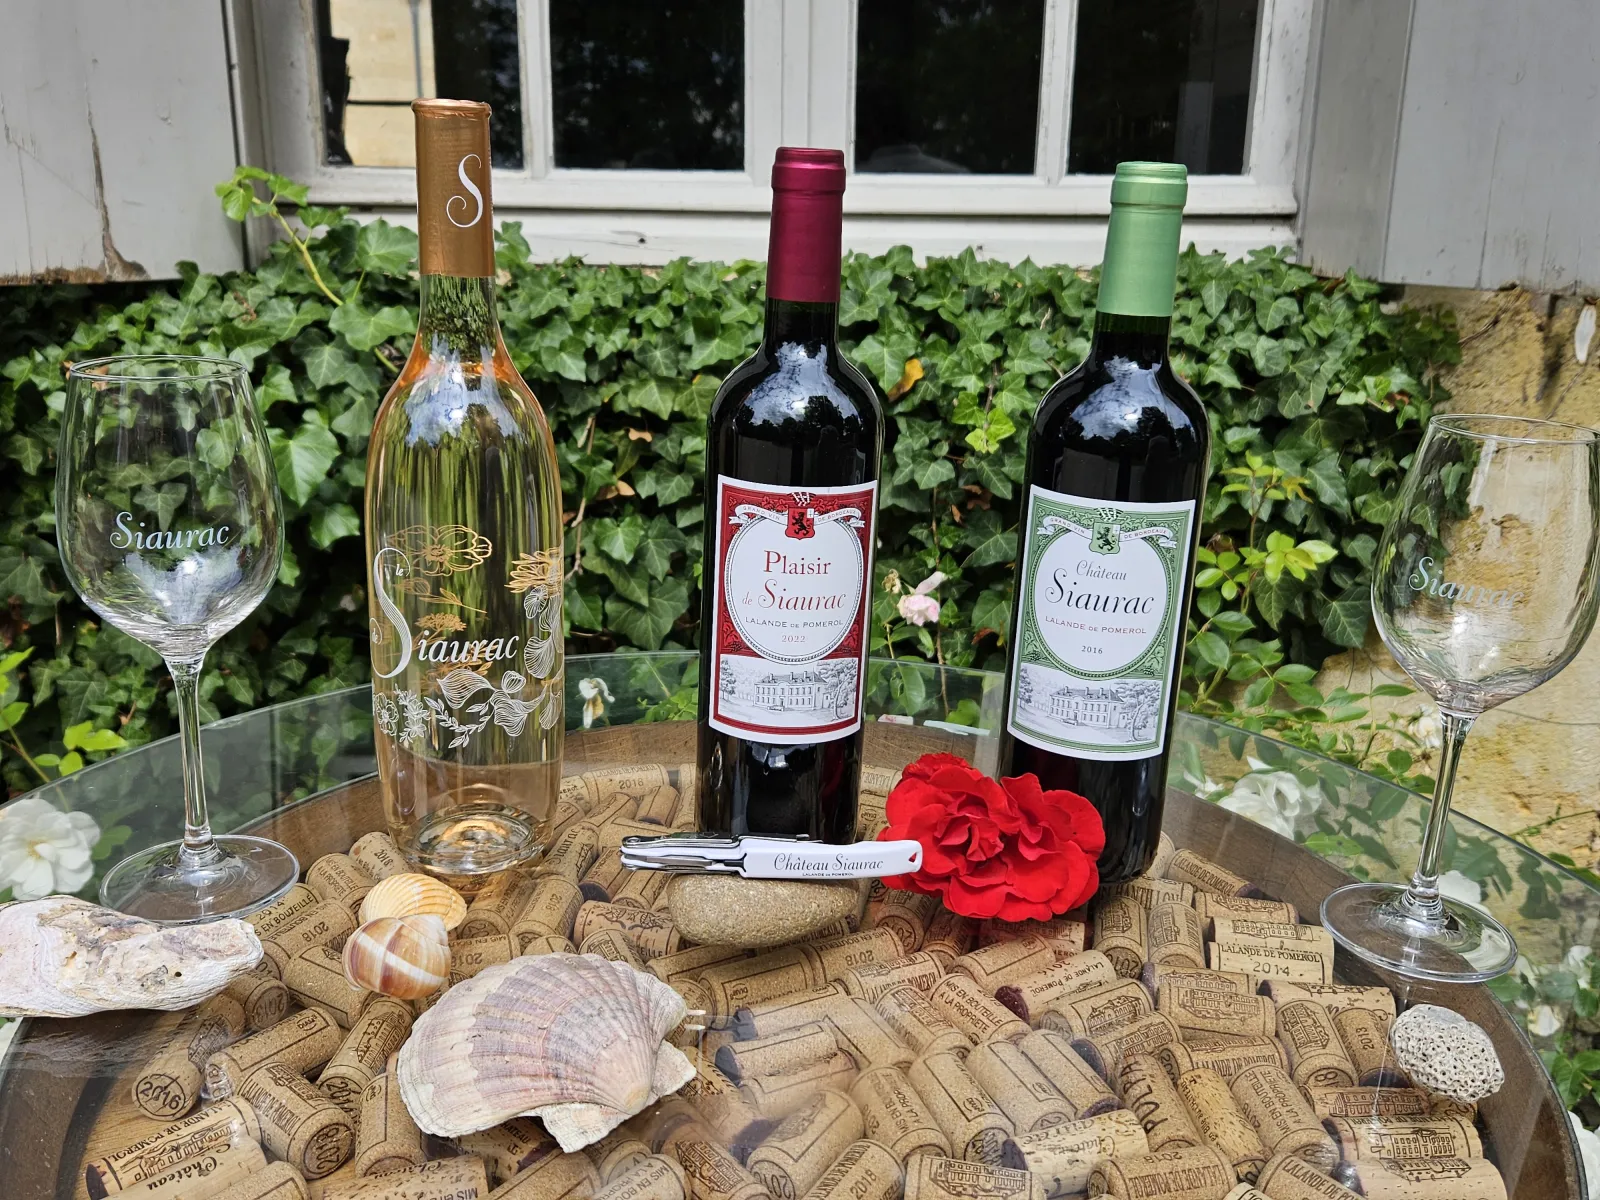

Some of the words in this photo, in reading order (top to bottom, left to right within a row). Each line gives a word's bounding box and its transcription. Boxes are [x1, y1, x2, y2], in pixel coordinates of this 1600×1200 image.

[447, 153, 483, 228] S
[110, 511, 229, 549] Siaurac
[763, 549, 831, 576] Plaisir
[1076, 559, 1128, 581] Château
[1045, 567, 1155, 615] Siaurac
[1408, 556, 1525, 609] Siaurac
[742, 591, 753, 606] de
[758, 578, 847, 611] Siaurac
[745, 617, 788, 628] LALANDE
[802, 619, 844, 629] POMEROL
[1045, 615, 1086, 631] LALANDE
[1088, 625, 1099, 633] DE
[1101, 625, 1147, 635] POMEROL
[781, 634, 806, 643] 2022
[1081, 645, 1103, 655] 2016
[774, 852, 828, 871] Château
[831, 853, 884, 870] Siaurac
[302, 921, 329, 942] 2018
[844, 950, 873, 967] 2018
[1221, 944, 1262, 957] LALANDE
[1264, 949, 1275, 958] DE
[1278, 951, 1320, 963] POMEROL
[1064, 974, 1073, 982] DE
[1074, 961, 1104, 977] LALANDE
[1253, 961, 1290, 977] 2014
[945, 981, 959, 992] MIS
[1356, 1026, 1375, 1050] 2013
[140, 1081, 182, 1110] 2016
[1120, 1061, 1168, 1134] PULPA
[1270, 1109, 1282, 1121] EN
[501, 1121, 531, 1144] HATEAU
[1277, 1119, 1291, 1135] MIS
[317, 1127, 340, 1170] 2018
[146, 1156, 218, 1191] Château
[652, 1164, 671, 1180] MIS
[1282, 1159, 1326, 1192] LALANDE
[1323, 1183, 1340, 1199] DE
[850, 1169, 877, 1200] 2018
